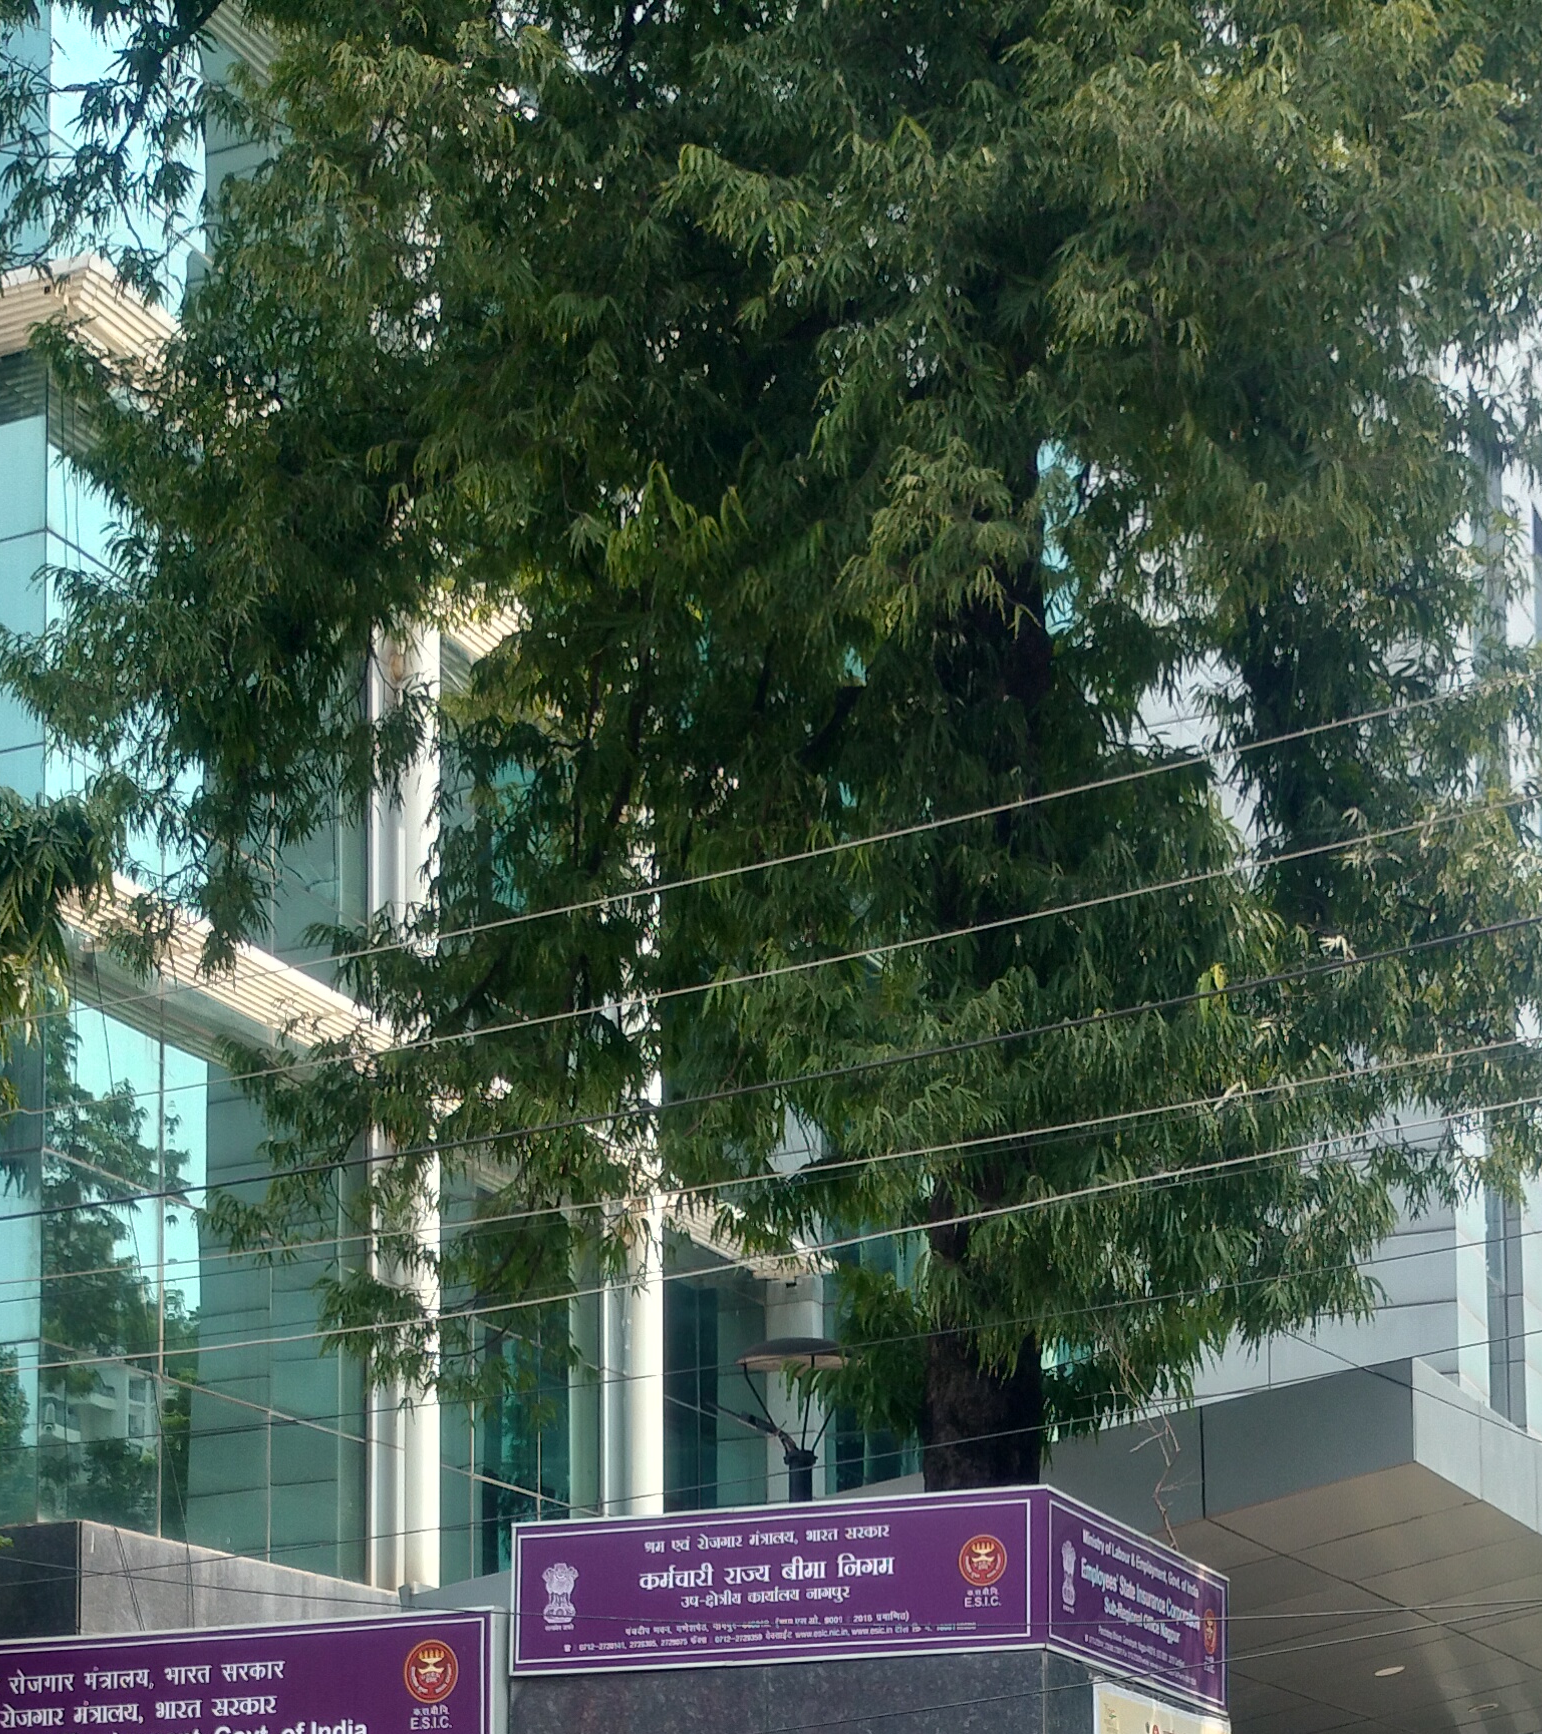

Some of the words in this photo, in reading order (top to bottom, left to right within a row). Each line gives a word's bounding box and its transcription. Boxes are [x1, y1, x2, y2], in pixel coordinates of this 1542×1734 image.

[645, 1541, 664, 1553] श्रम
[671, 1536, 690, 1552] एवं
[697, 1534, 743, 1550] रोजगार
[805, 1528, 838, 1543] भारत
[845, 1524, 890, 1540] सरकार
[639, 1562, 714, 1590] कर्मचारी
[724, 1565, 770, 1585] राज्य
[781, 1555, 826, 1581] बीमा
[837, 1553, 895, 1578] निगम
[747, 1587, 799, 1604] कार्यालय
[806, 1585, 851, 1604] नागपुर
[964, 1595, 1002, 1608] E.S.I.C.
[1119, 1574, 1136, 1601] State
[8, 1669, 74, 1696] रोजगार
[164, 1665, 211, 1686] भारत
[221, 1660, 285, 1683] सरकार
[0, 1703, 64, 1729] रोजगार
[73, 1700, 144, 1726] मंत्रालय,
[155, 1699, 202, 1721] भारत
[211, 1695, 277, 1718] सरकार
[410, 1715, 453, 1730] E.S.I.C.
